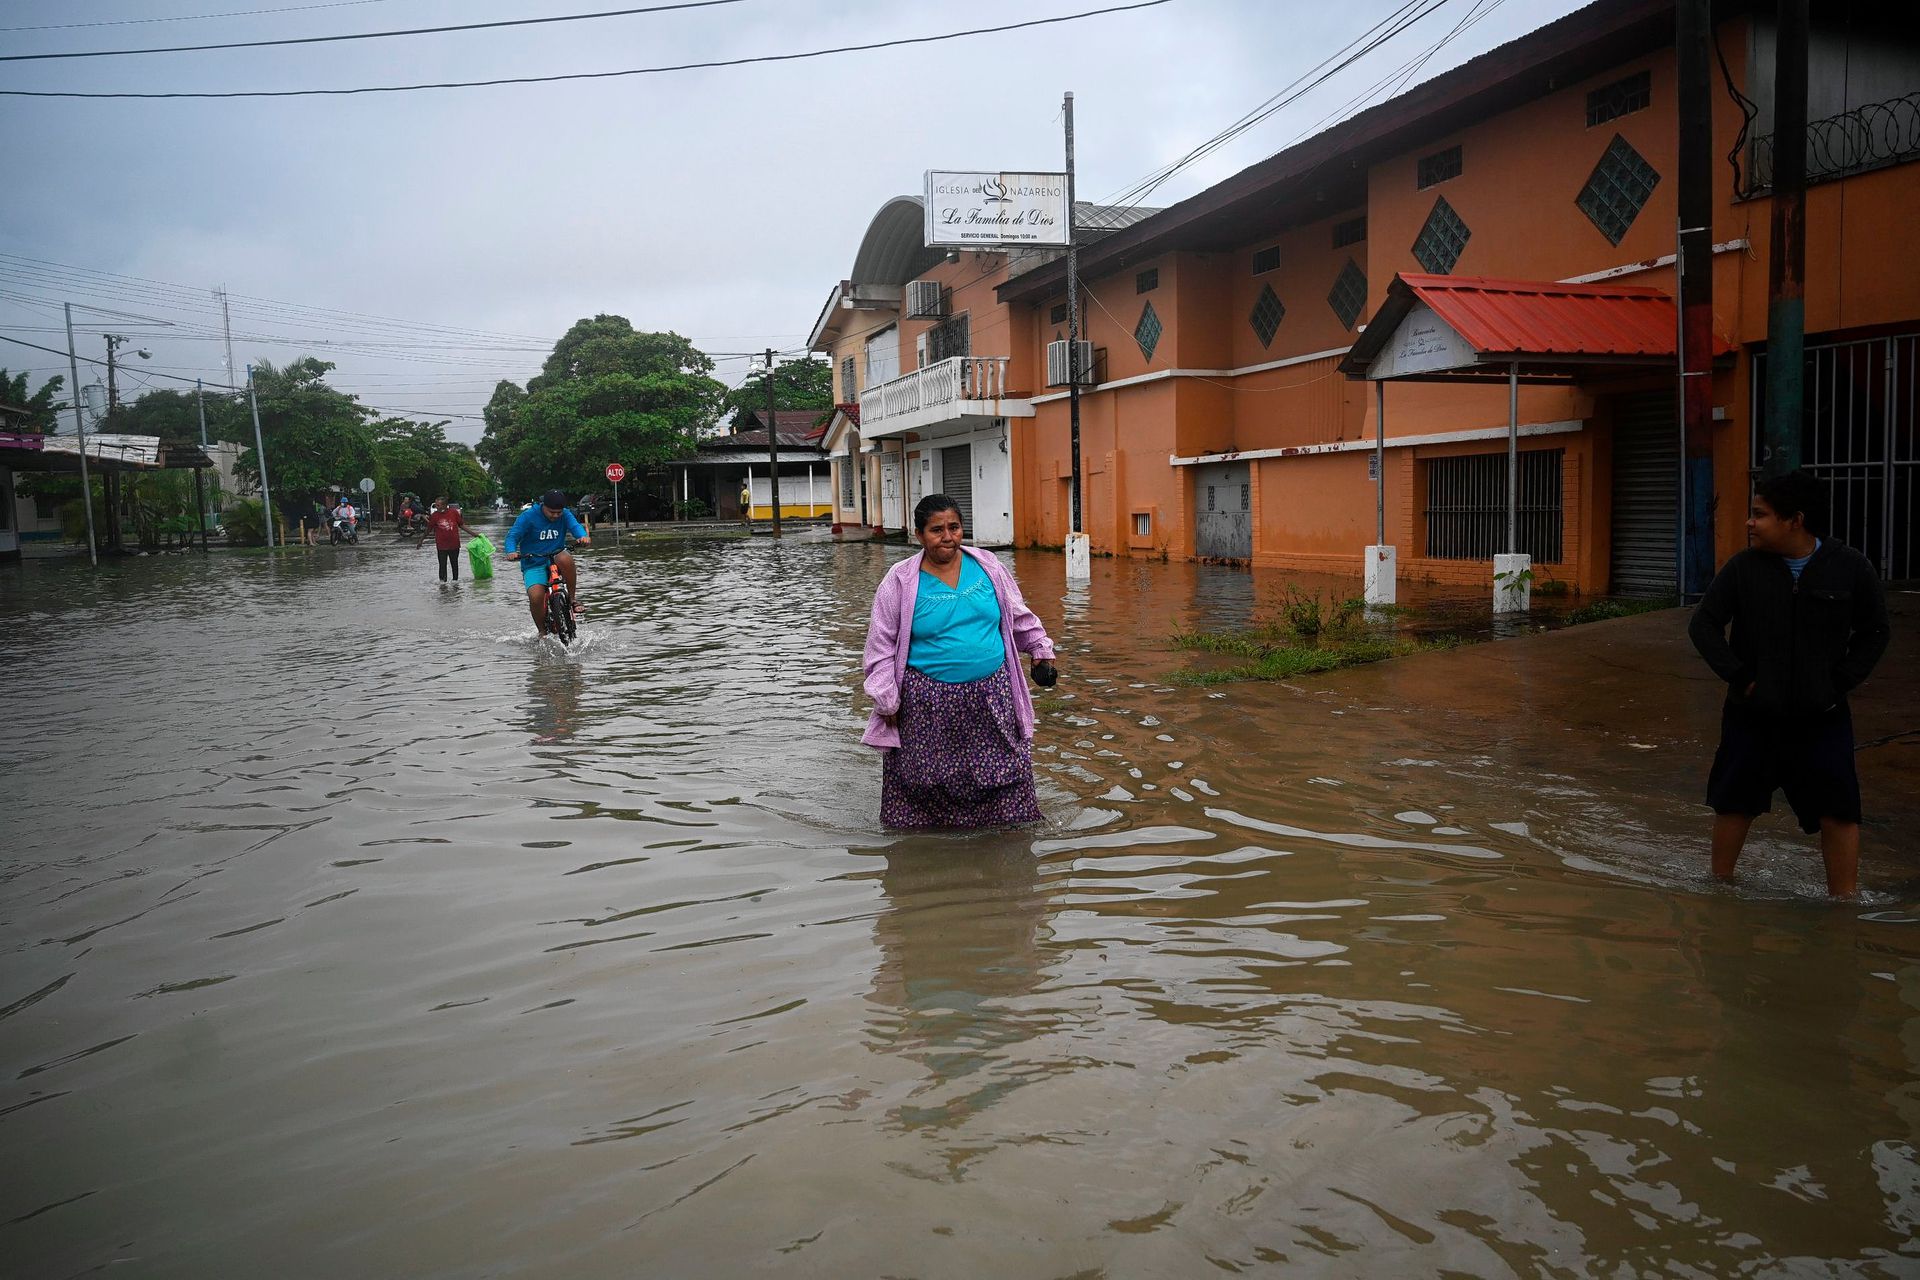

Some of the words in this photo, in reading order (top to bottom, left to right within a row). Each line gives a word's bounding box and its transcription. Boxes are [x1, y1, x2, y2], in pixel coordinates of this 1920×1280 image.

[936, 186, 969, 194] IGLESIA
[1010, 187, 1061, 197] NAZARENO
[942, 208, 961, 225] La
[965, 208, 1009, 225] Familia
[1012, 210, 1024, 226] de
[1027, 208, 1054, 226] Dios
[608, 468, 624, 477] ALTO
[540, 529, 559, 540] GAP
